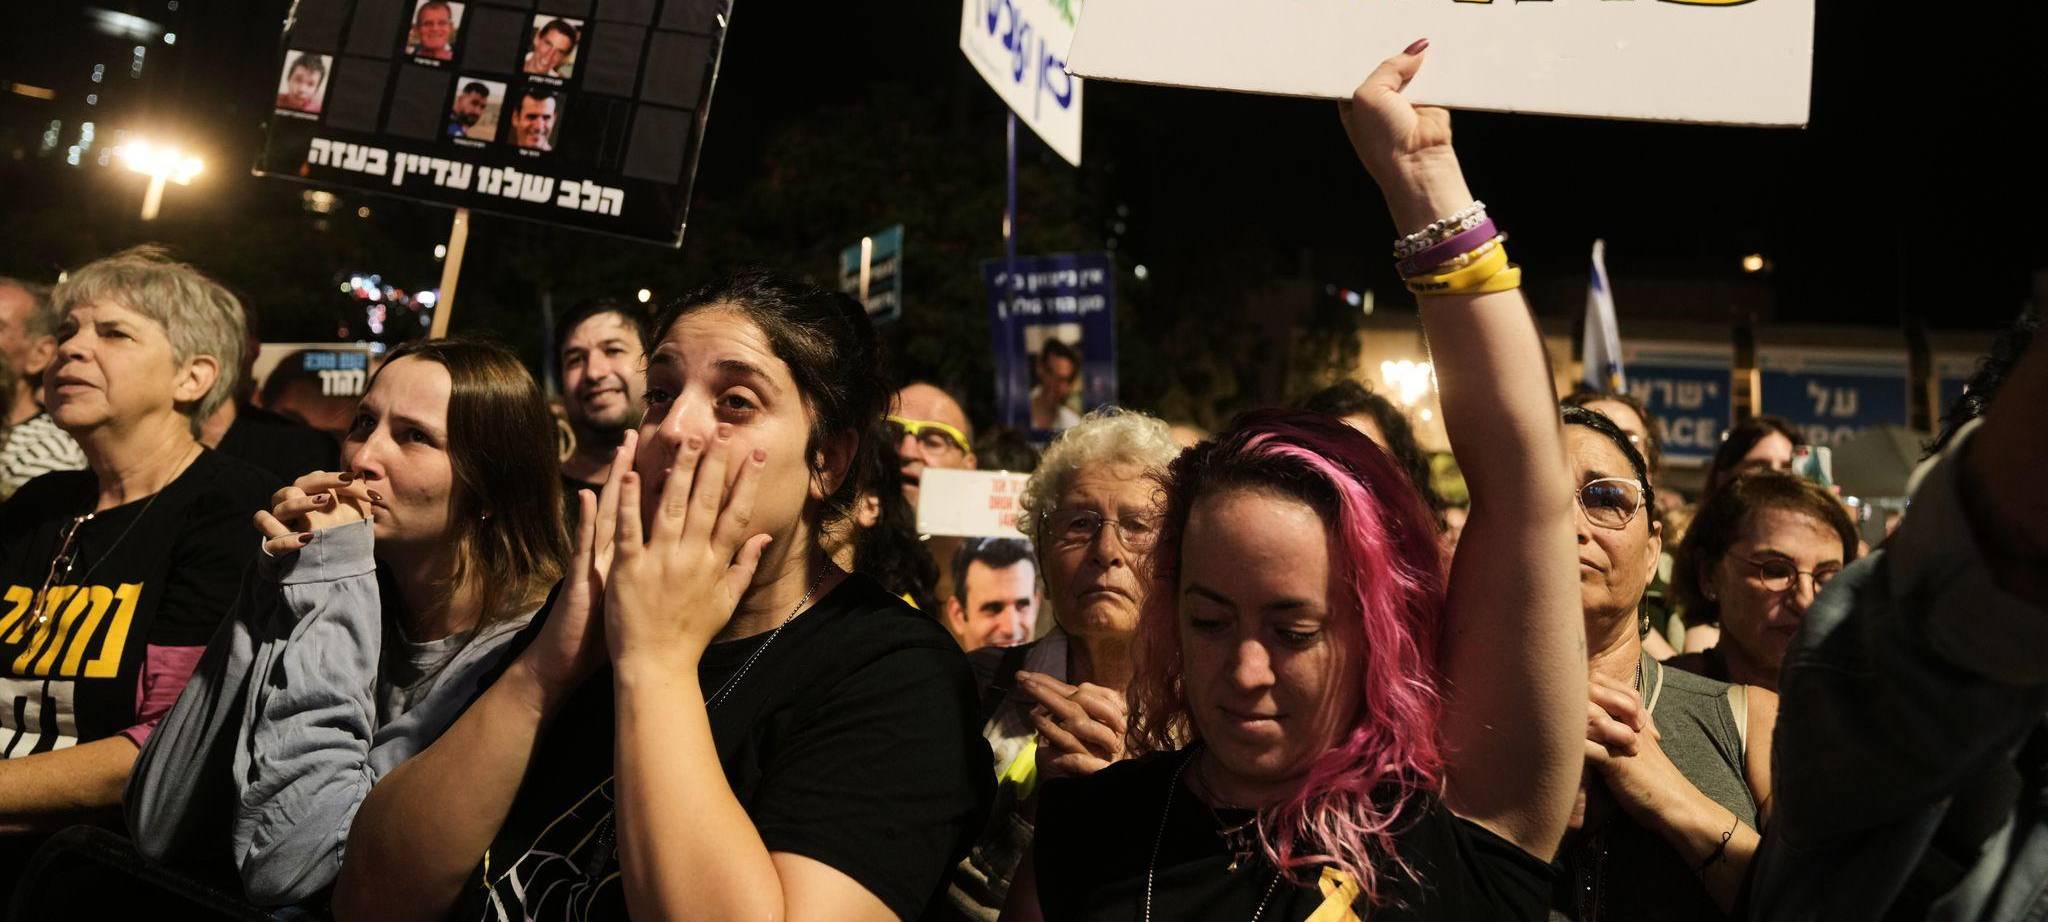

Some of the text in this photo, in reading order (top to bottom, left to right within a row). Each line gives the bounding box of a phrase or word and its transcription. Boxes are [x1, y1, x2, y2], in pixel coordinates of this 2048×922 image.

[307, 137, 625, 217] הלב שלנו עדיין בעזה
[1629, 380, 1719, 409] ישרא
[1806, 380, 1857, 416] על
[1656, 416, 1716, 448] ACE
